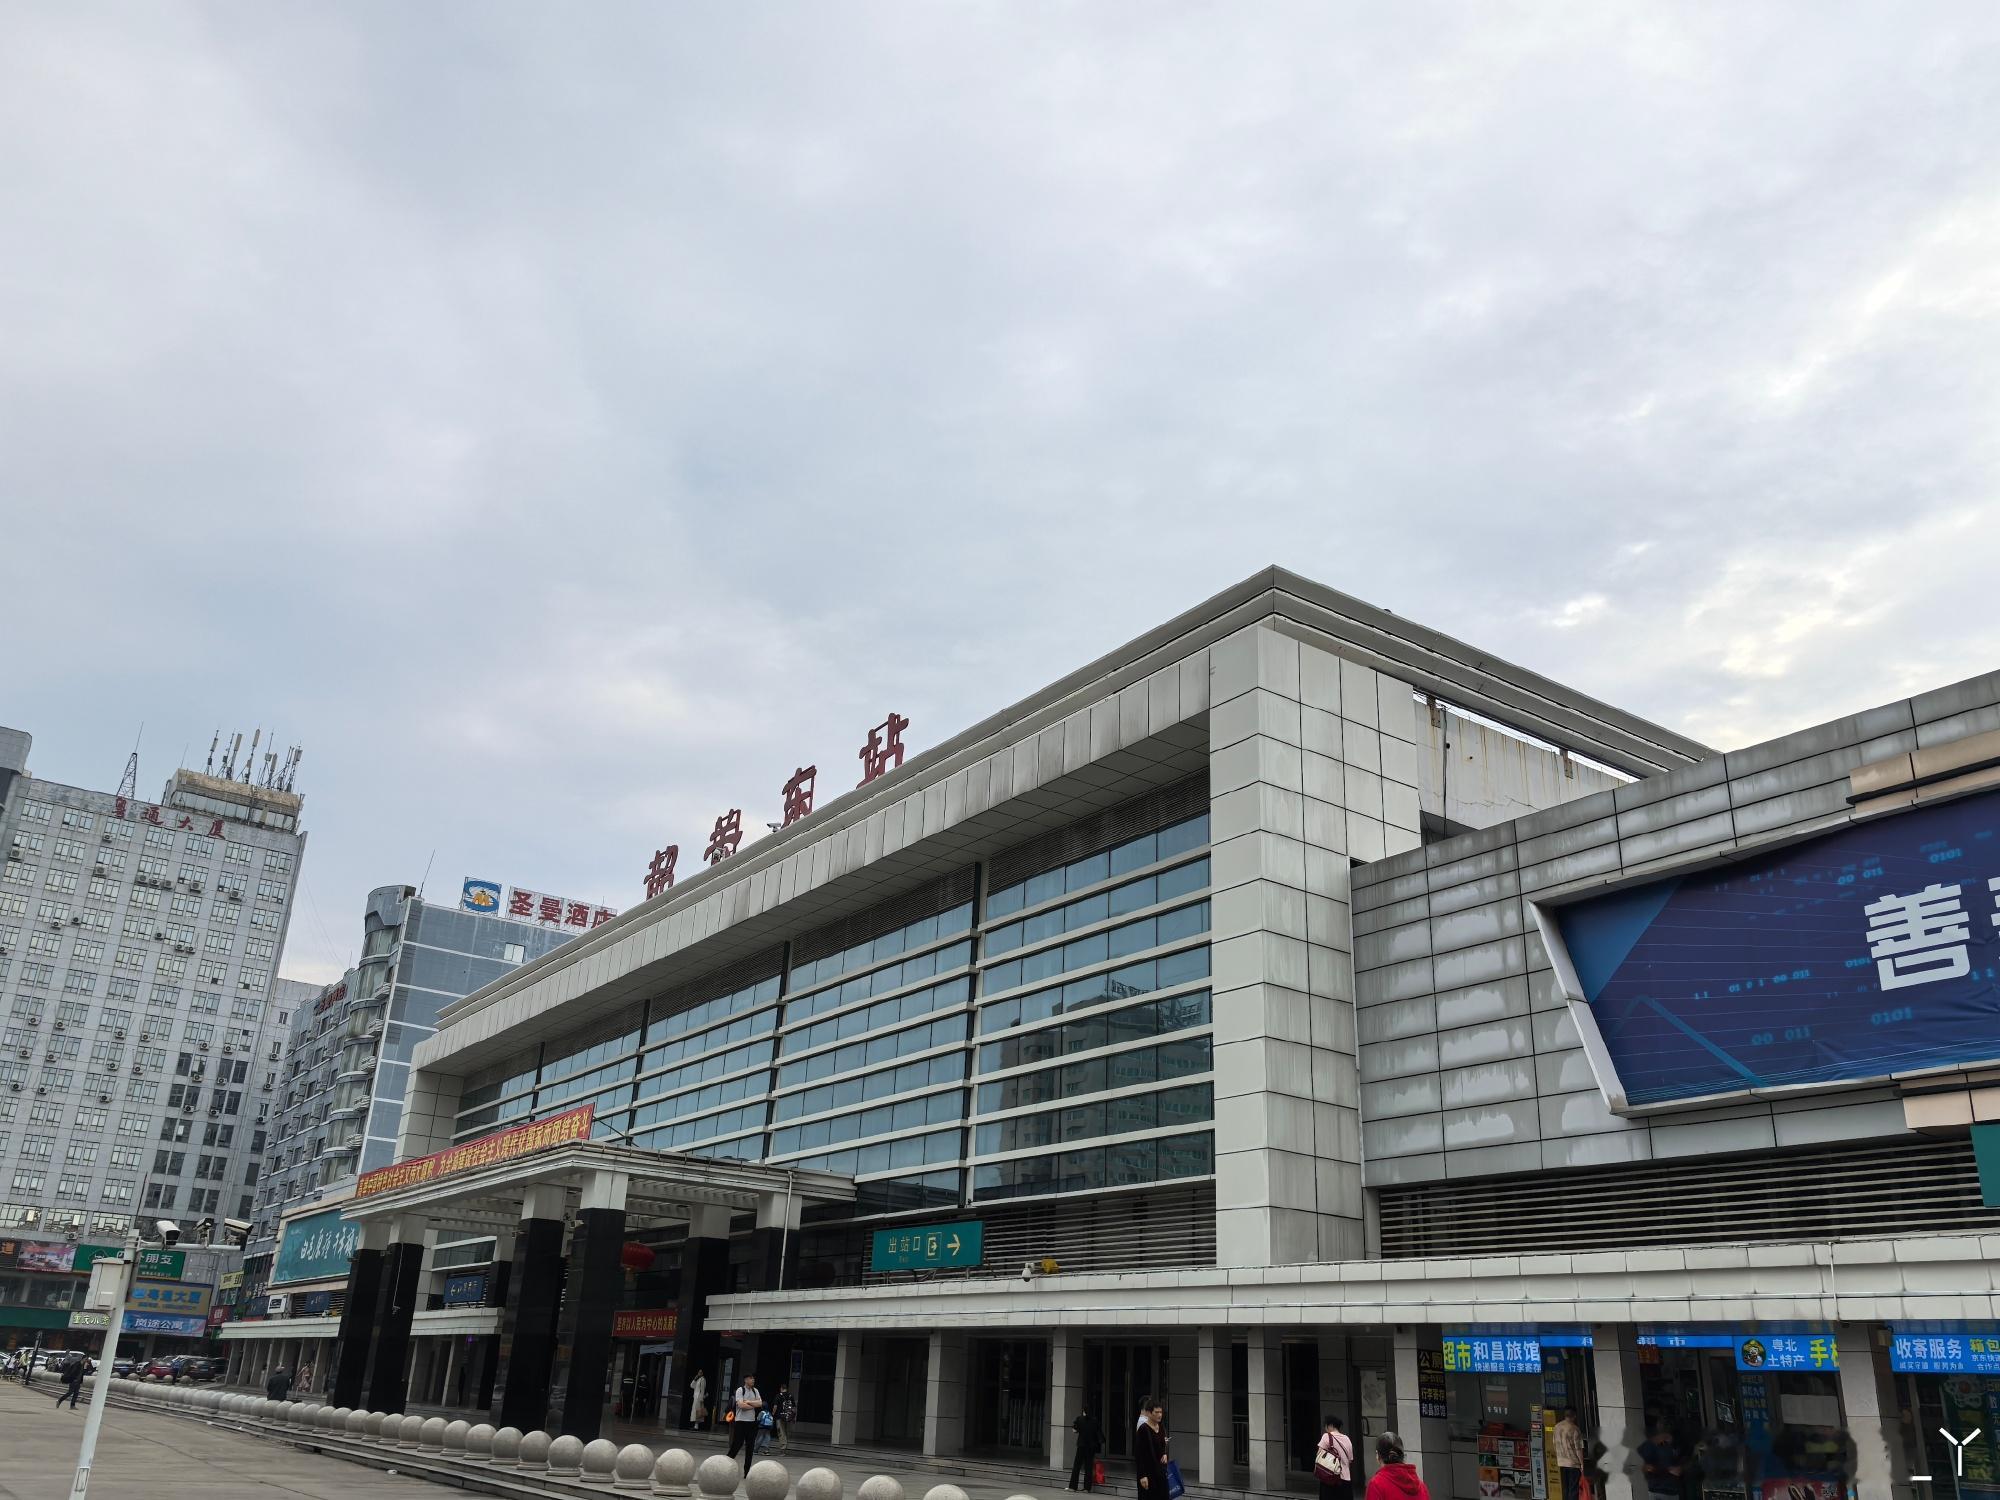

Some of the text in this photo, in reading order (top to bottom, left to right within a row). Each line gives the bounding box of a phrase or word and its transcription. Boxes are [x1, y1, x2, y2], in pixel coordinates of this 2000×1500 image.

[1864, 877, 2000, 992] 善
[888, 1236, 921, 1254] 出站口
[1443, 1341, 1471, 1371] 超市
[1473, 1340, 1541, 1361] 和昌旅馆
[1772, 1339, 1797, 1352] 粤北
[1896, 1338, 1962, 1359] 收寄服务
[1768, 1354, 1805, 1367] 土特产
